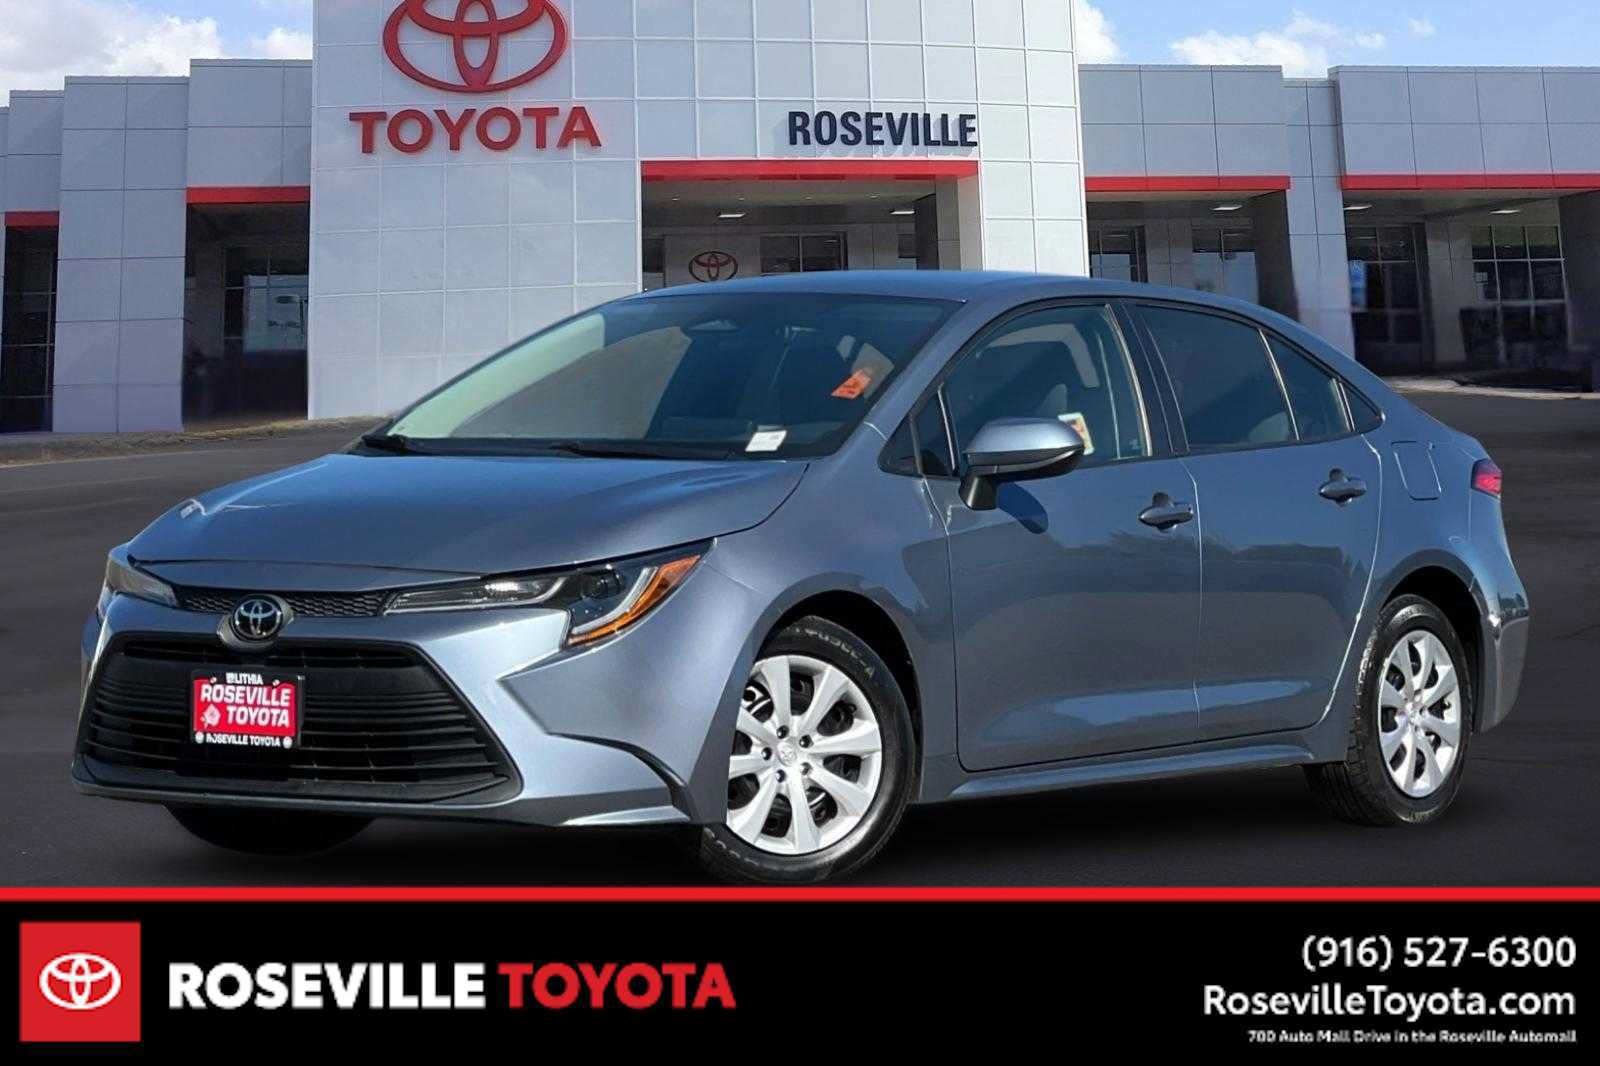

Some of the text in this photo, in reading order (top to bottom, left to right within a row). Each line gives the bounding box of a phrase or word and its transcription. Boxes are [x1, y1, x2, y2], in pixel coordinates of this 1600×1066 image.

[349, 106, 602, 154] TOYOTA
[788, 110, 978, 147] ROSEVILLE
[235, 673, 263, 685] LITHIA
[201, 684, 292, 706] ROSEVILLE
[226, 705, 290, 728] TOYOTA
[206, 733, 281, 747] ROSEVILLE TOYOTA
